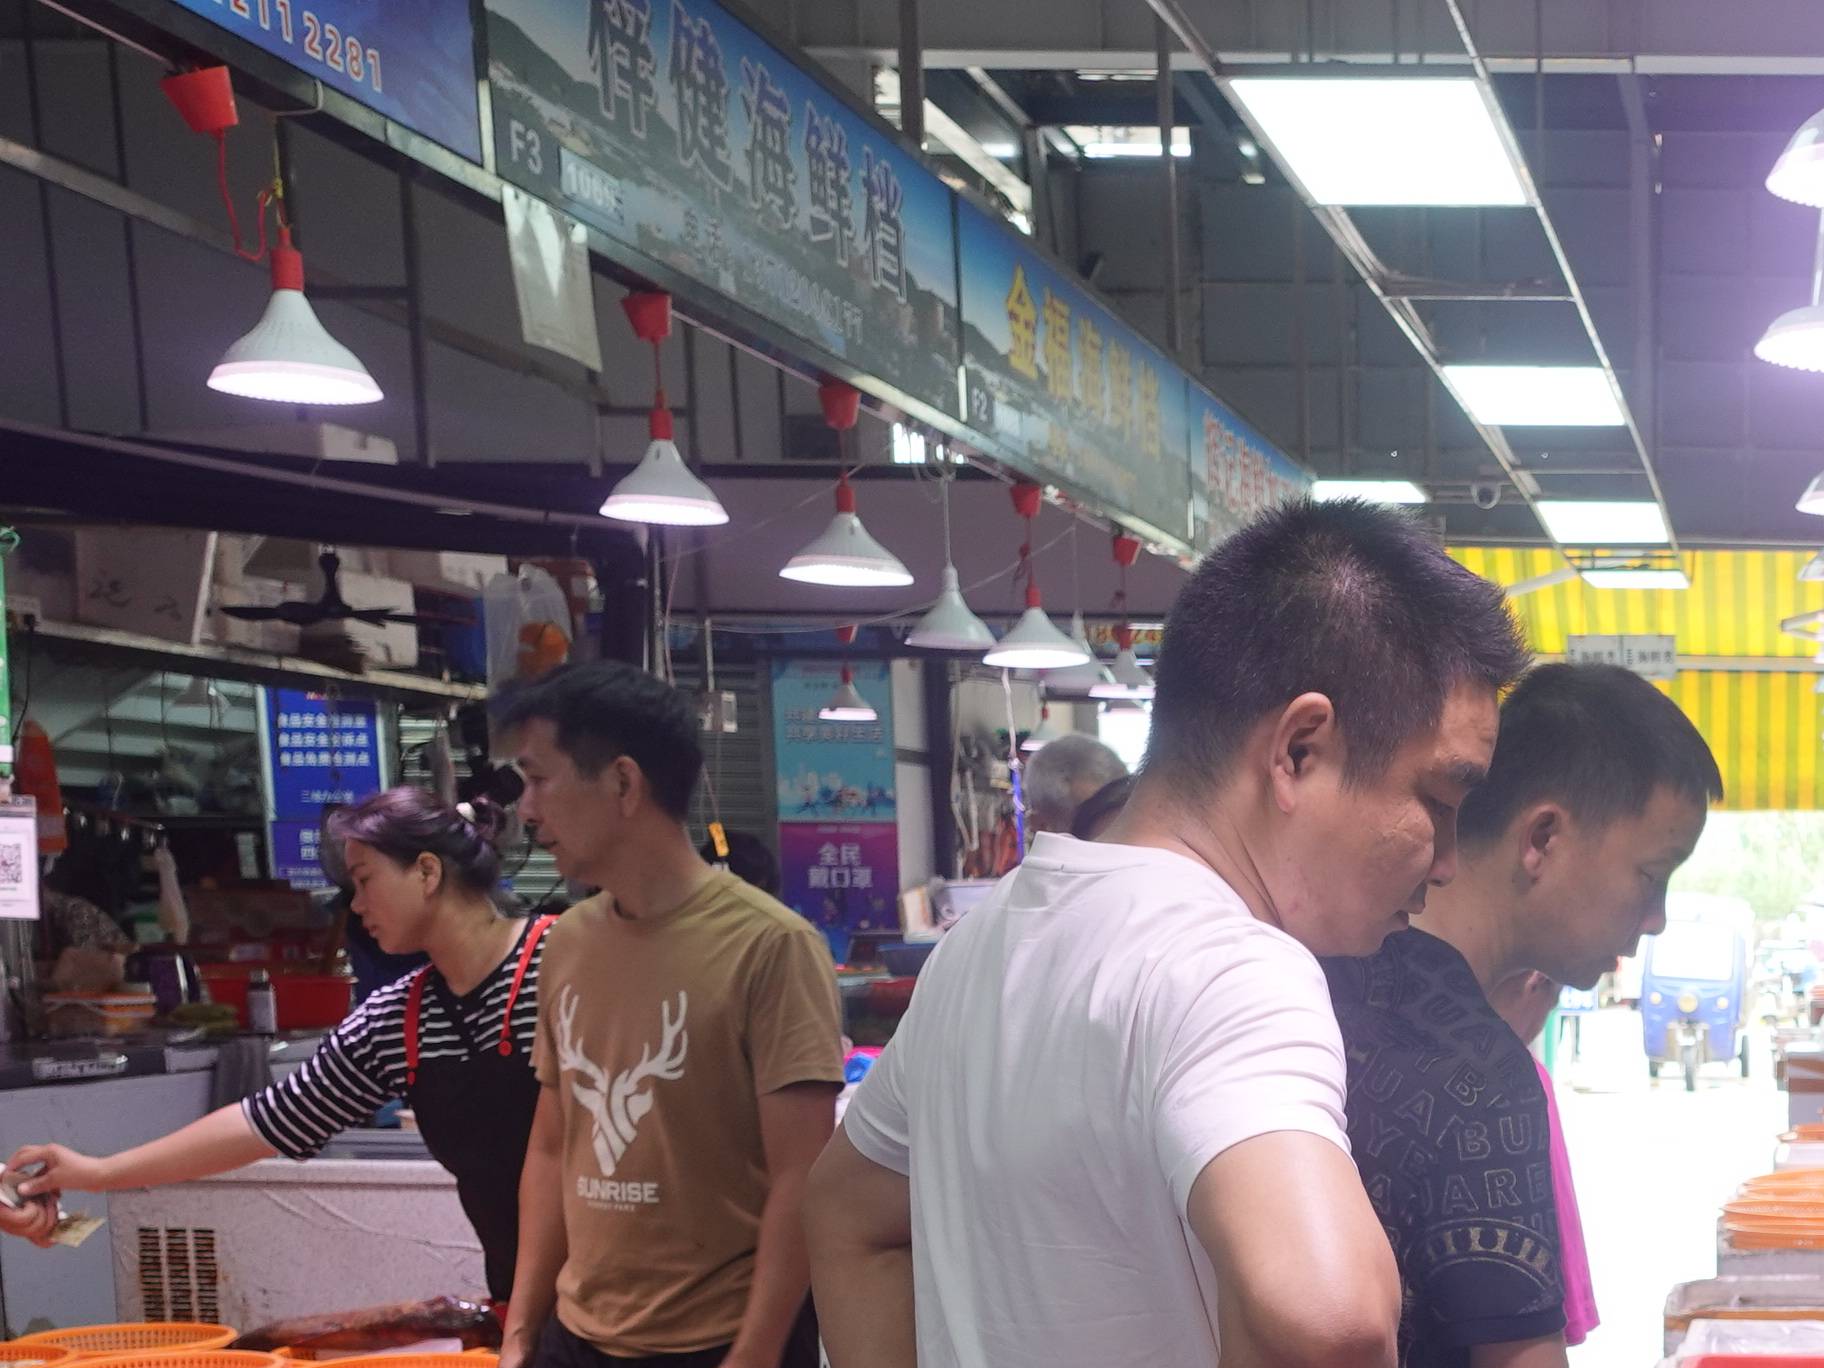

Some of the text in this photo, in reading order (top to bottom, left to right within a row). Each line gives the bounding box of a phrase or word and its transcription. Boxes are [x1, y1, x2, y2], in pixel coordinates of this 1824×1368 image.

[510, 119, 543, 175] F3
[972, 388, 988, 422] F2
[818, 841, 861, 867] 全民
[576, 1175, 660, 1203] SUNRISE
